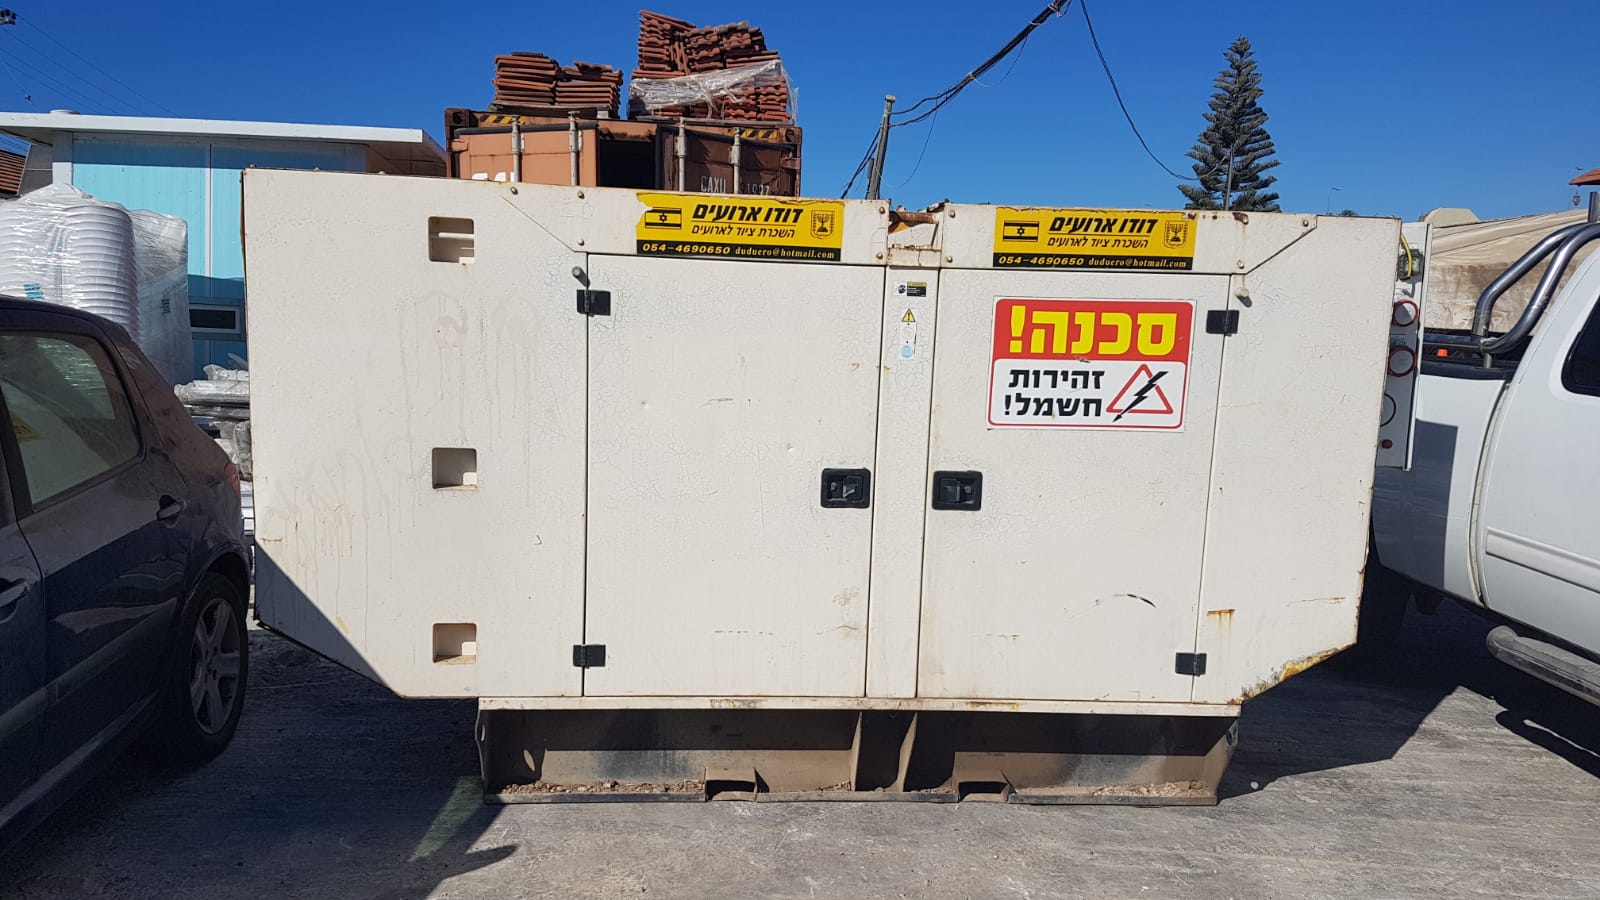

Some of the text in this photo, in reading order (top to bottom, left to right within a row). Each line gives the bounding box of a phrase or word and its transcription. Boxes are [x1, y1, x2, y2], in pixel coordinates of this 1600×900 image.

[692, 203, 804, 224] דודו ארועים
[691, 223, 796, 239] השכרת ציוד לארועים
[1049, 216, 1158, 234] דודו ארועים
[642, 243, 730, 255] 054-4690650
[1047, 236, 1149, 249] השכרת ציוד לארועים
[998, 256, 1085, 266] 054-4690650
[1009, 305, 1177, 356] סכנה!
[1008, 368, 1105, 389] זהירות
[1004, 392, 1103, 417] חשמל!
